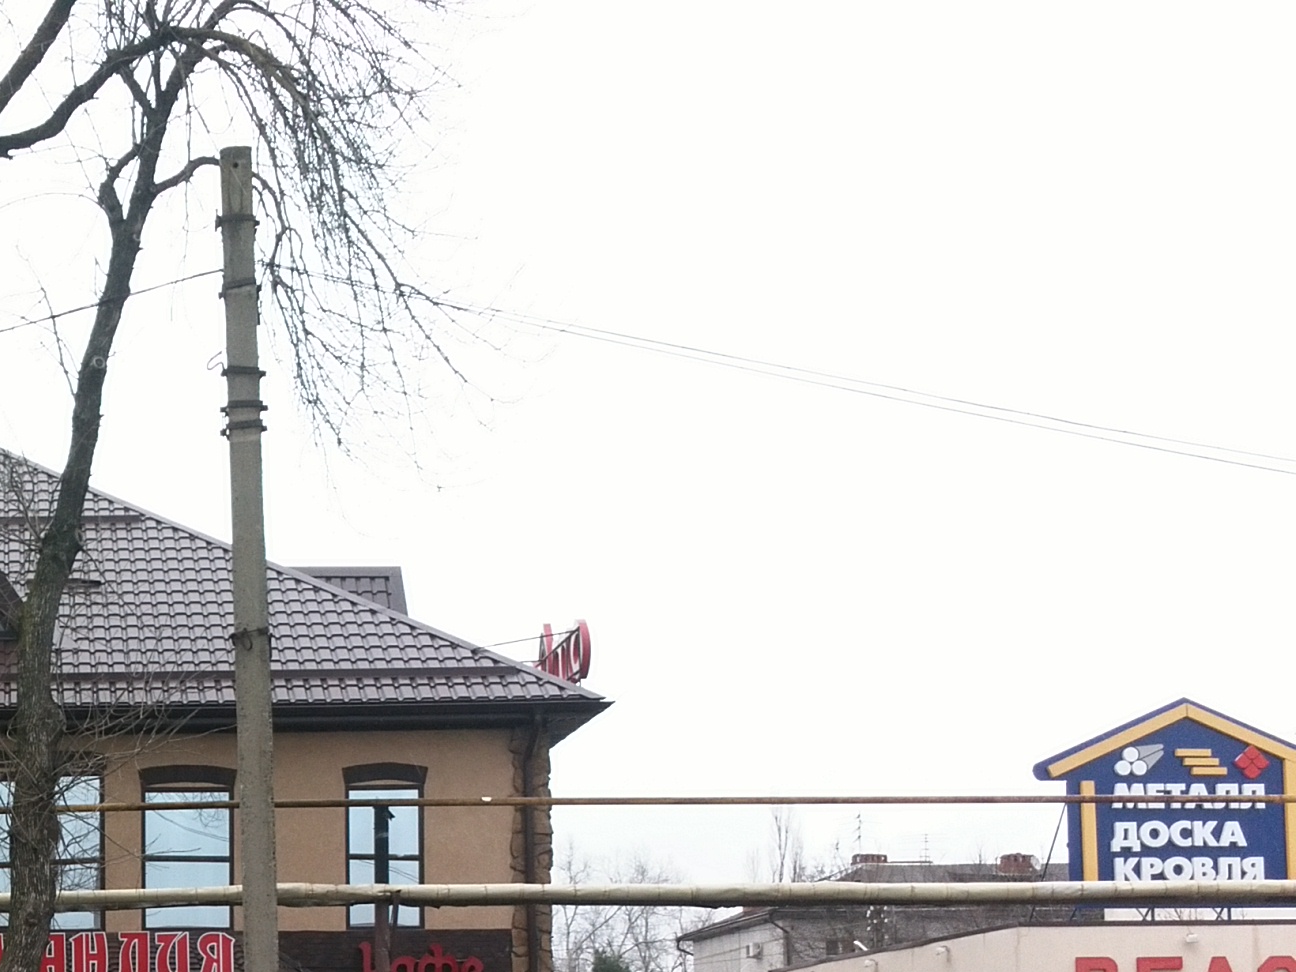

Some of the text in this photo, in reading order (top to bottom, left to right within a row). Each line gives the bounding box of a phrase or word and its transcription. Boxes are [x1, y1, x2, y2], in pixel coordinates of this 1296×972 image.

[1112, 783, 1266, 809] МЕТАЛЛ
[1110, 820, 1247, 852] ДОСКА
[1113, 856, 1265, 882] КРОВЛЯ
